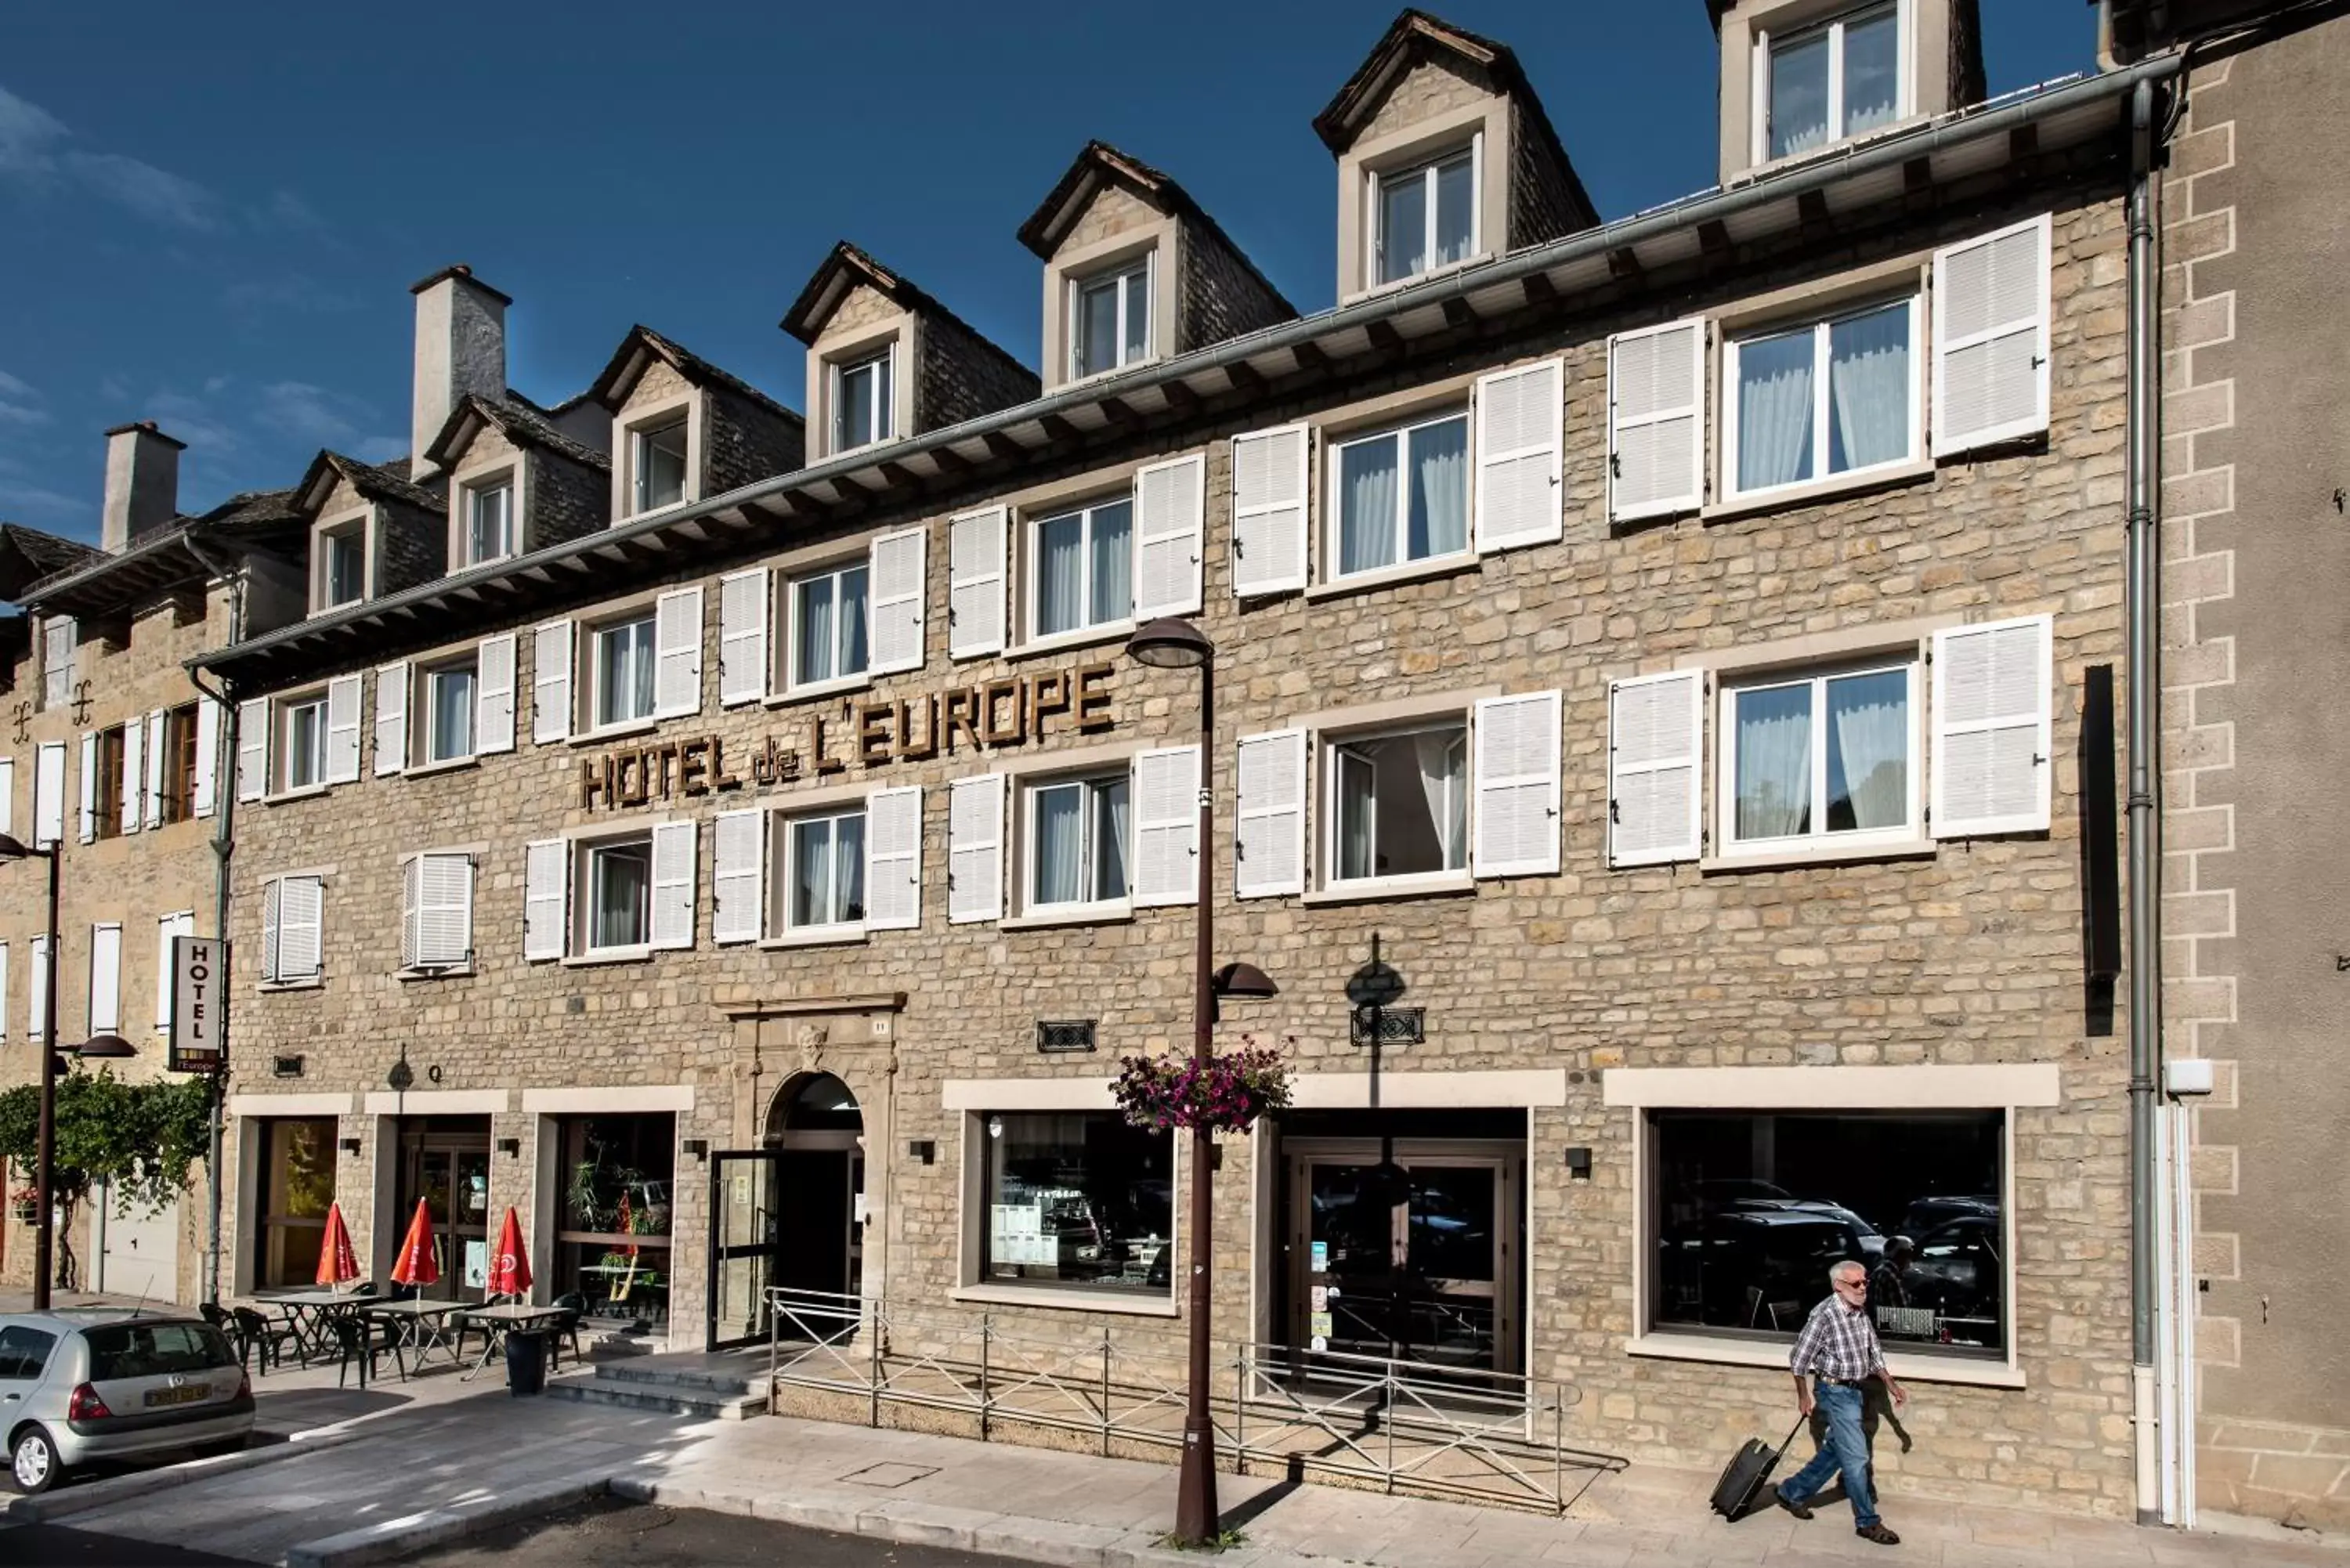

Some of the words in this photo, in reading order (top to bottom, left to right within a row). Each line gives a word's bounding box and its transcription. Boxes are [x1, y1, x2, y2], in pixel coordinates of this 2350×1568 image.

[579, 733, 736, 807] HOTEL
[751, 735, 797, 782] de
[811, 662, 1112, 770] L'EUROPE
[190, 946, 208, 1039] HOTEL
